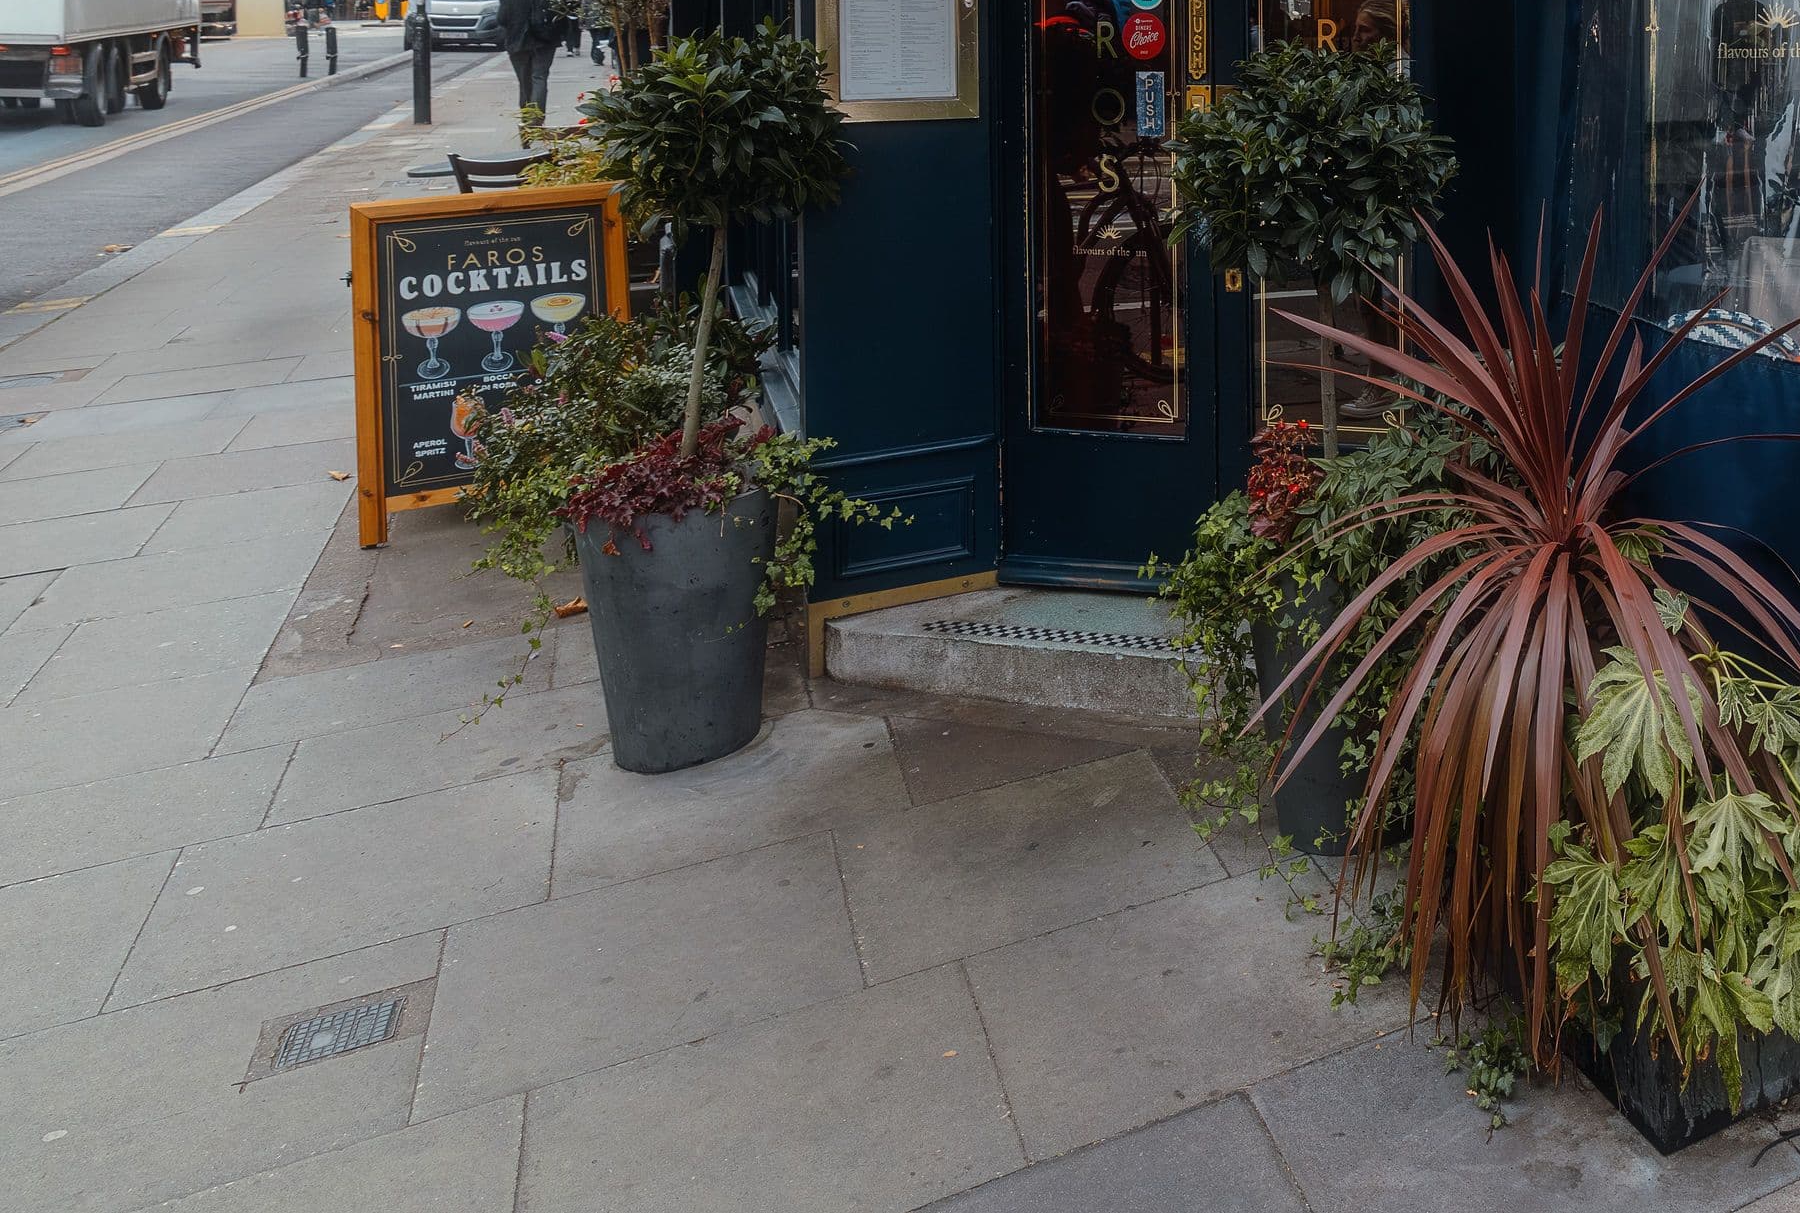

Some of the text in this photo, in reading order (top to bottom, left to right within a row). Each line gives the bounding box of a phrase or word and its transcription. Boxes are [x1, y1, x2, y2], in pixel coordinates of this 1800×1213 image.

[1130, 31, 1159, 49] Choice
[1193, 0, 1203, 69] PUSH
[1717, 42, 1769, 59] flavours
[1772, 41, 1788, 58] of
[1145, 78, 1155, 130] PUSH
[447, 246, 544, 270] FAROS
[1072, 245, 1105, 256] flavours
[1106, 246, 1118, 256] of
[400, 259, 588, 300] COCKTAILS
[410, 380, 457, 393] TIRAMISU
[413, 389, 455, 401] MARTINI
[413, 438, 448, 449] APEROL
[415, 448, 446, 458] SPRITZ
